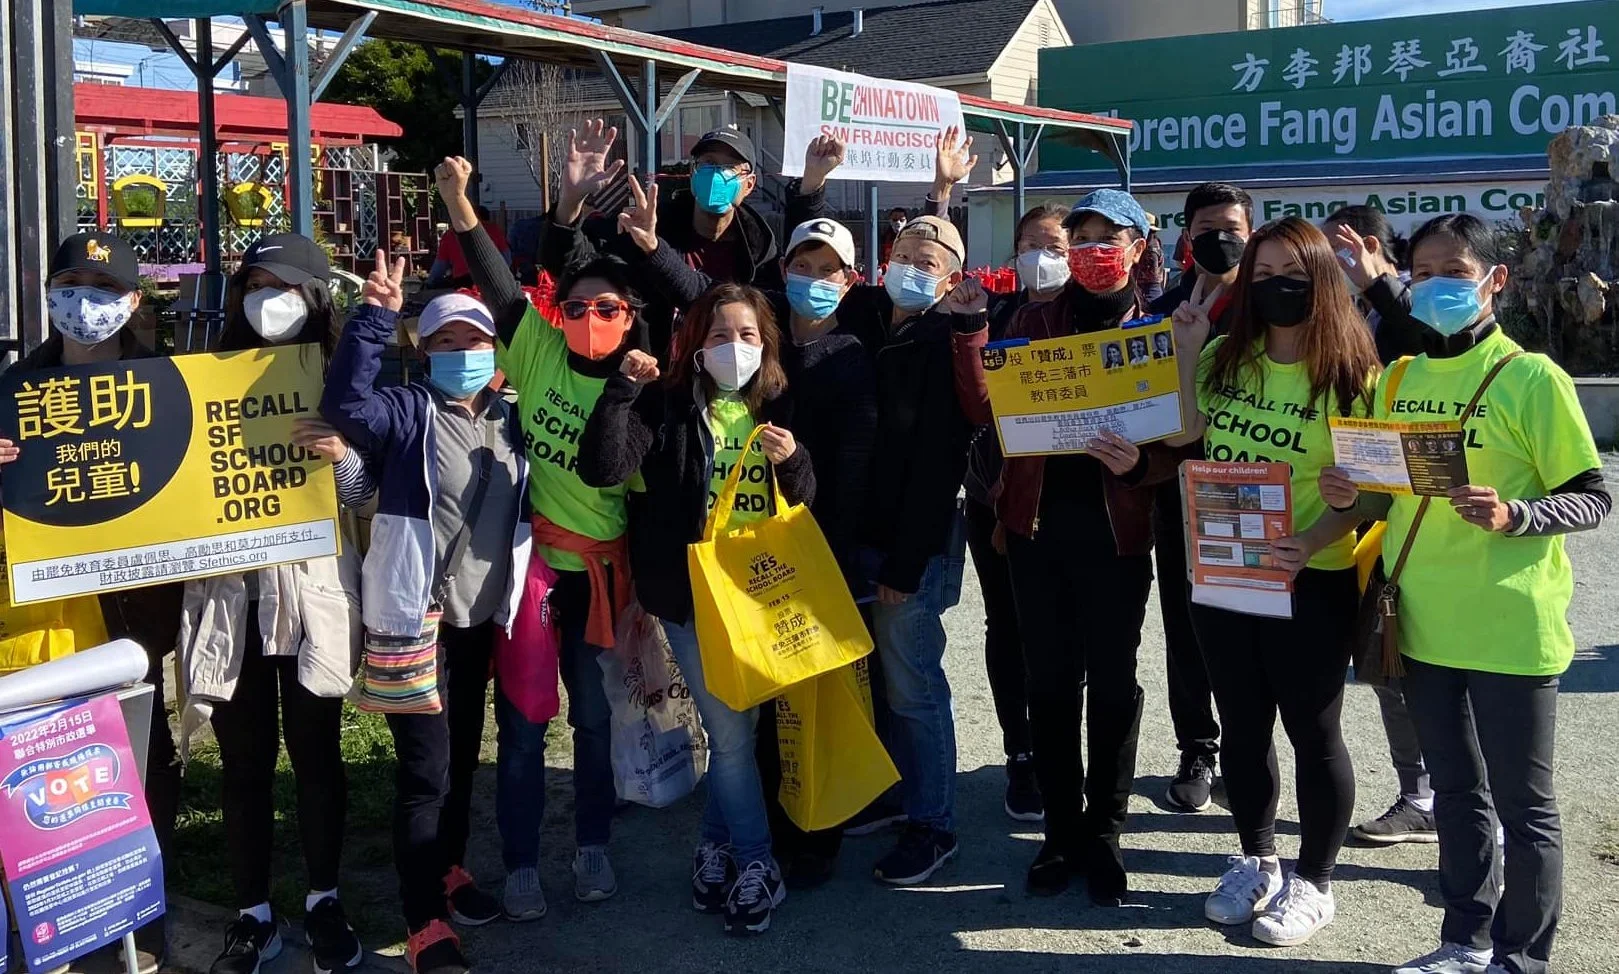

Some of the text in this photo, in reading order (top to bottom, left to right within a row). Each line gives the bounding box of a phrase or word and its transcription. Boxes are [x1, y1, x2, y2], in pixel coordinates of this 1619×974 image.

[1231, 25, 1610, 92] 方李邦琴亞裔社
[1260, 101, 1357, 154] Fang
[1370, 89, 1492, 141] Asian
[1365, 191, 1466, 215] Asian
[14, 370, 153, 441] 護助
[205, 391, 309, 423] RECALL
[544, 387, 588, 421] RECAL
[1029, 384, 1089, 403] 教育委員
[532, 407, 580, 445] SCH
[1282, 402, 1320, 421] THE
[207, 423, 242, 448] SF
[714, 435, 743, 450] ALL
[55, 438, 121, 464] 我們的
[210, 443, 321, 473] SCHOOL
[524, 429, 579, 472] BOAR
[213, 466, 307, 498] BOARD
[1191, 464, 1212, 474] Help
[1228, 465, 1268, 475] children!
[216, 494, 281, 523] .ORG
[748, 563, 787, 585] RECALL THE
[749, 556, 777, 575] YES
[746, 580, 772, 594] SCHOOL
[773, 567, 796, 582] BOARD
[10, 709, 94, 747] 2022年2月15日
[28, 766, 110, 807] VOTE
